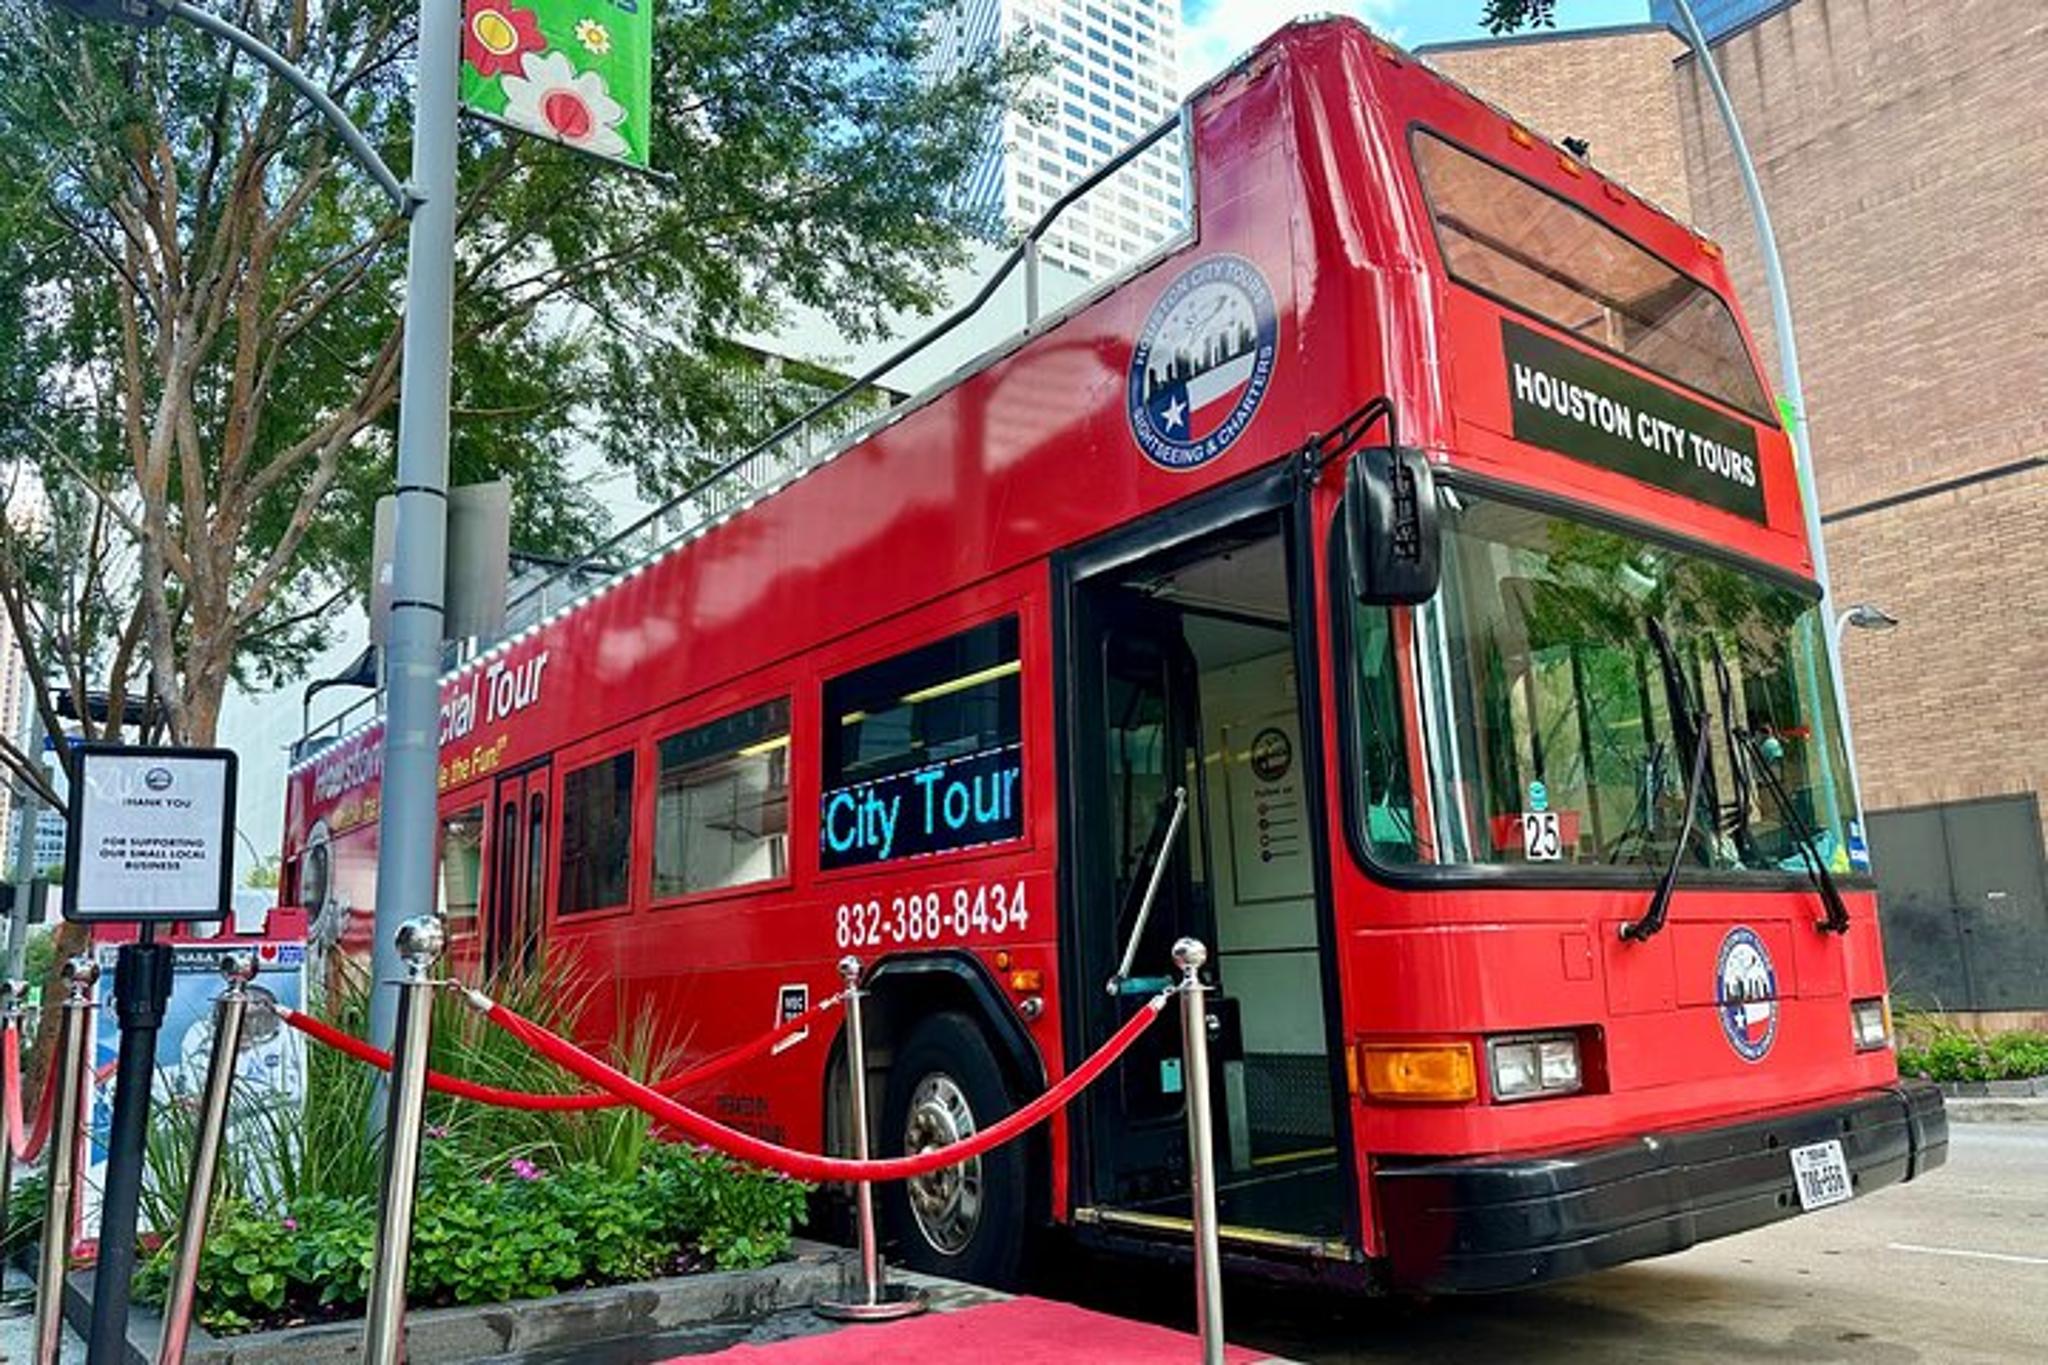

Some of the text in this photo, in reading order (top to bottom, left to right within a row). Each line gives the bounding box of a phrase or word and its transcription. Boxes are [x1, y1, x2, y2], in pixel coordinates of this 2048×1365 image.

[1191, 261, 1224, 287] CITY
[1133, 345, 1273, 465] SIGHTSEEING & CHARTERS
[1513, 362, 1756, 487] HOUSTON CITY TOURS
[486, 650, 549, 723] Tour
[167, 799, 192, 808] YOU
[827, 767, 1020, 860] City Tour
[102, 838, 204, 848] FOR SUPPORTING
[1527, 815, 1559, 857] 25
[100, 850, 205, 859] OUR SMALL LOCAL
[124, 862, 180, 870] BUSINESS
[836, 880, 1028, 948] 832-388-8434
[177, 953, 214, 962] NASA
